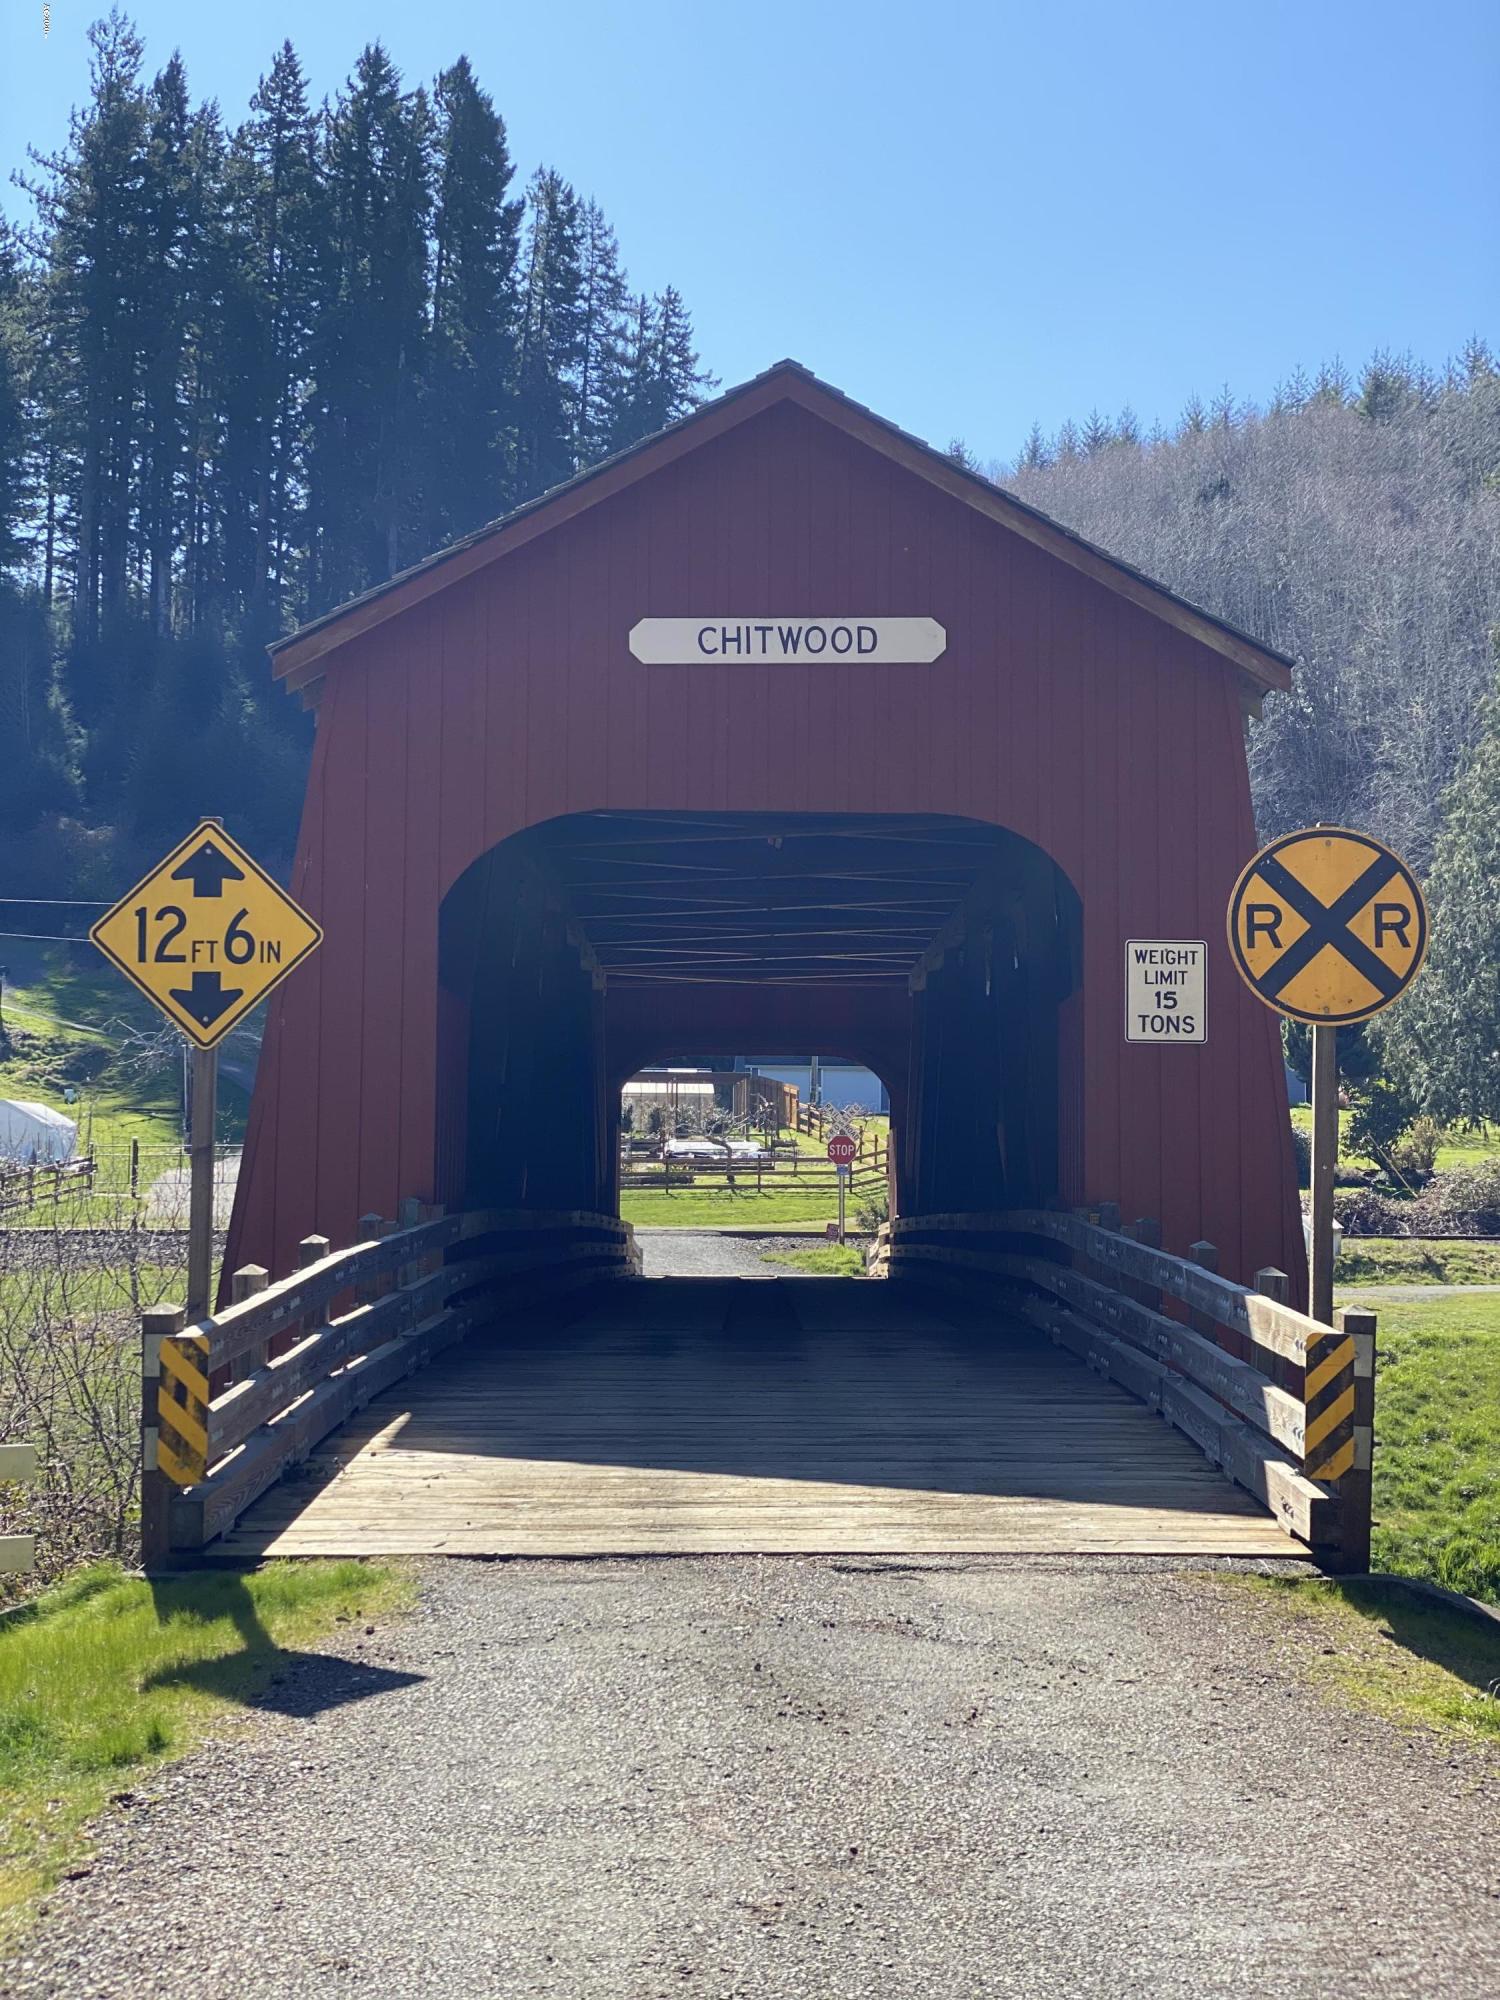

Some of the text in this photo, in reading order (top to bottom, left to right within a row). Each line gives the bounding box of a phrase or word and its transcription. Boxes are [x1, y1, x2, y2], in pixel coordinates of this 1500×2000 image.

[697, 626, 878, 655] CHITWOOD
[134, 905, 281, 965] 12 FT 6 IN
[1245, 902, 1412, 949] R R
[1134, 949, 1199, 966] WEIGHT
[1144, 970, 1188, 985] LIMIT
[1154, 991, 1178, 1010] 15
[1137, 1014, 1195, 1034] TONS
[829, 1144, 855, 1156] STOP
